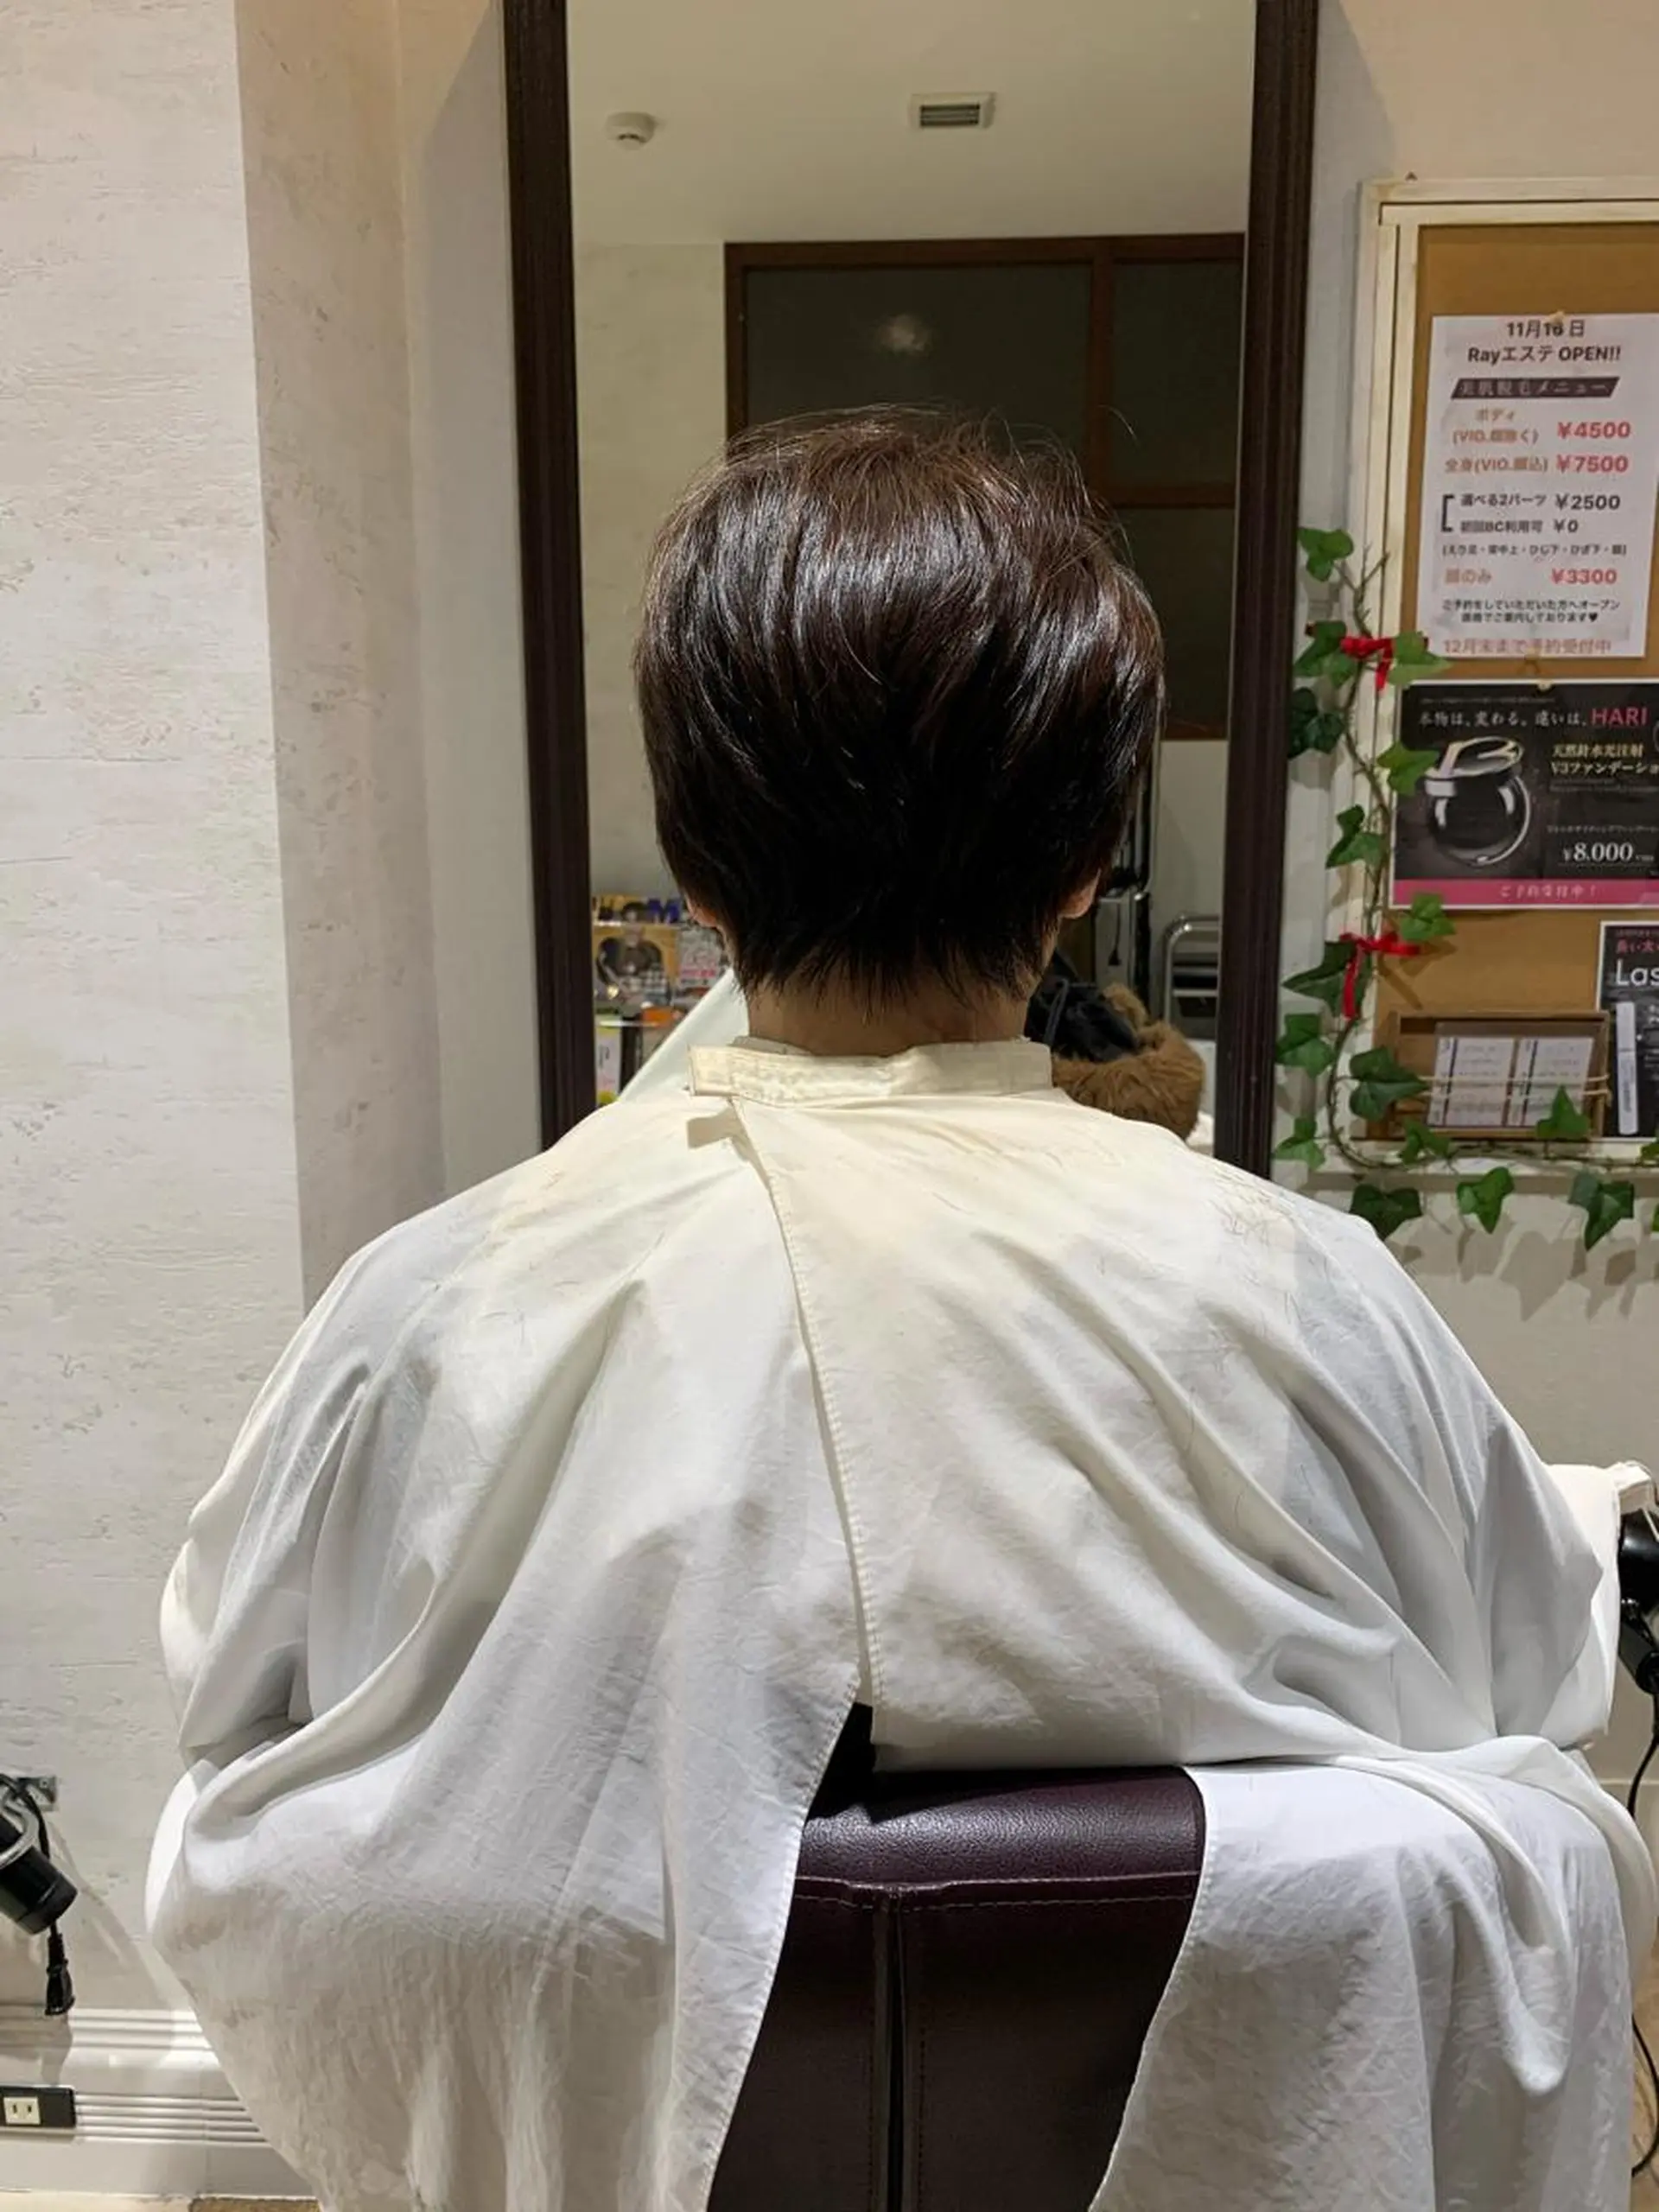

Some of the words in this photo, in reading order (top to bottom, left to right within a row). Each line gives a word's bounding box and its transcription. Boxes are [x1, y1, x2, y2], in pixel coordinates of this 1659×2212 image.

[1468, 346, 1553, 365] Rayエステ
[1559, 346, 1621, 361] OPEN!!
[1558, 422, 1631, 439] ¥4500
[1556, 454, 1629, 473] ¥7500
[1555, 494, 1621, 511] ¥2500
[1554, 520, 1579, 533] ¥0
[1551, 569, 1618, 585] ¥3300
[1591, 707, 1648, 726] HARI
